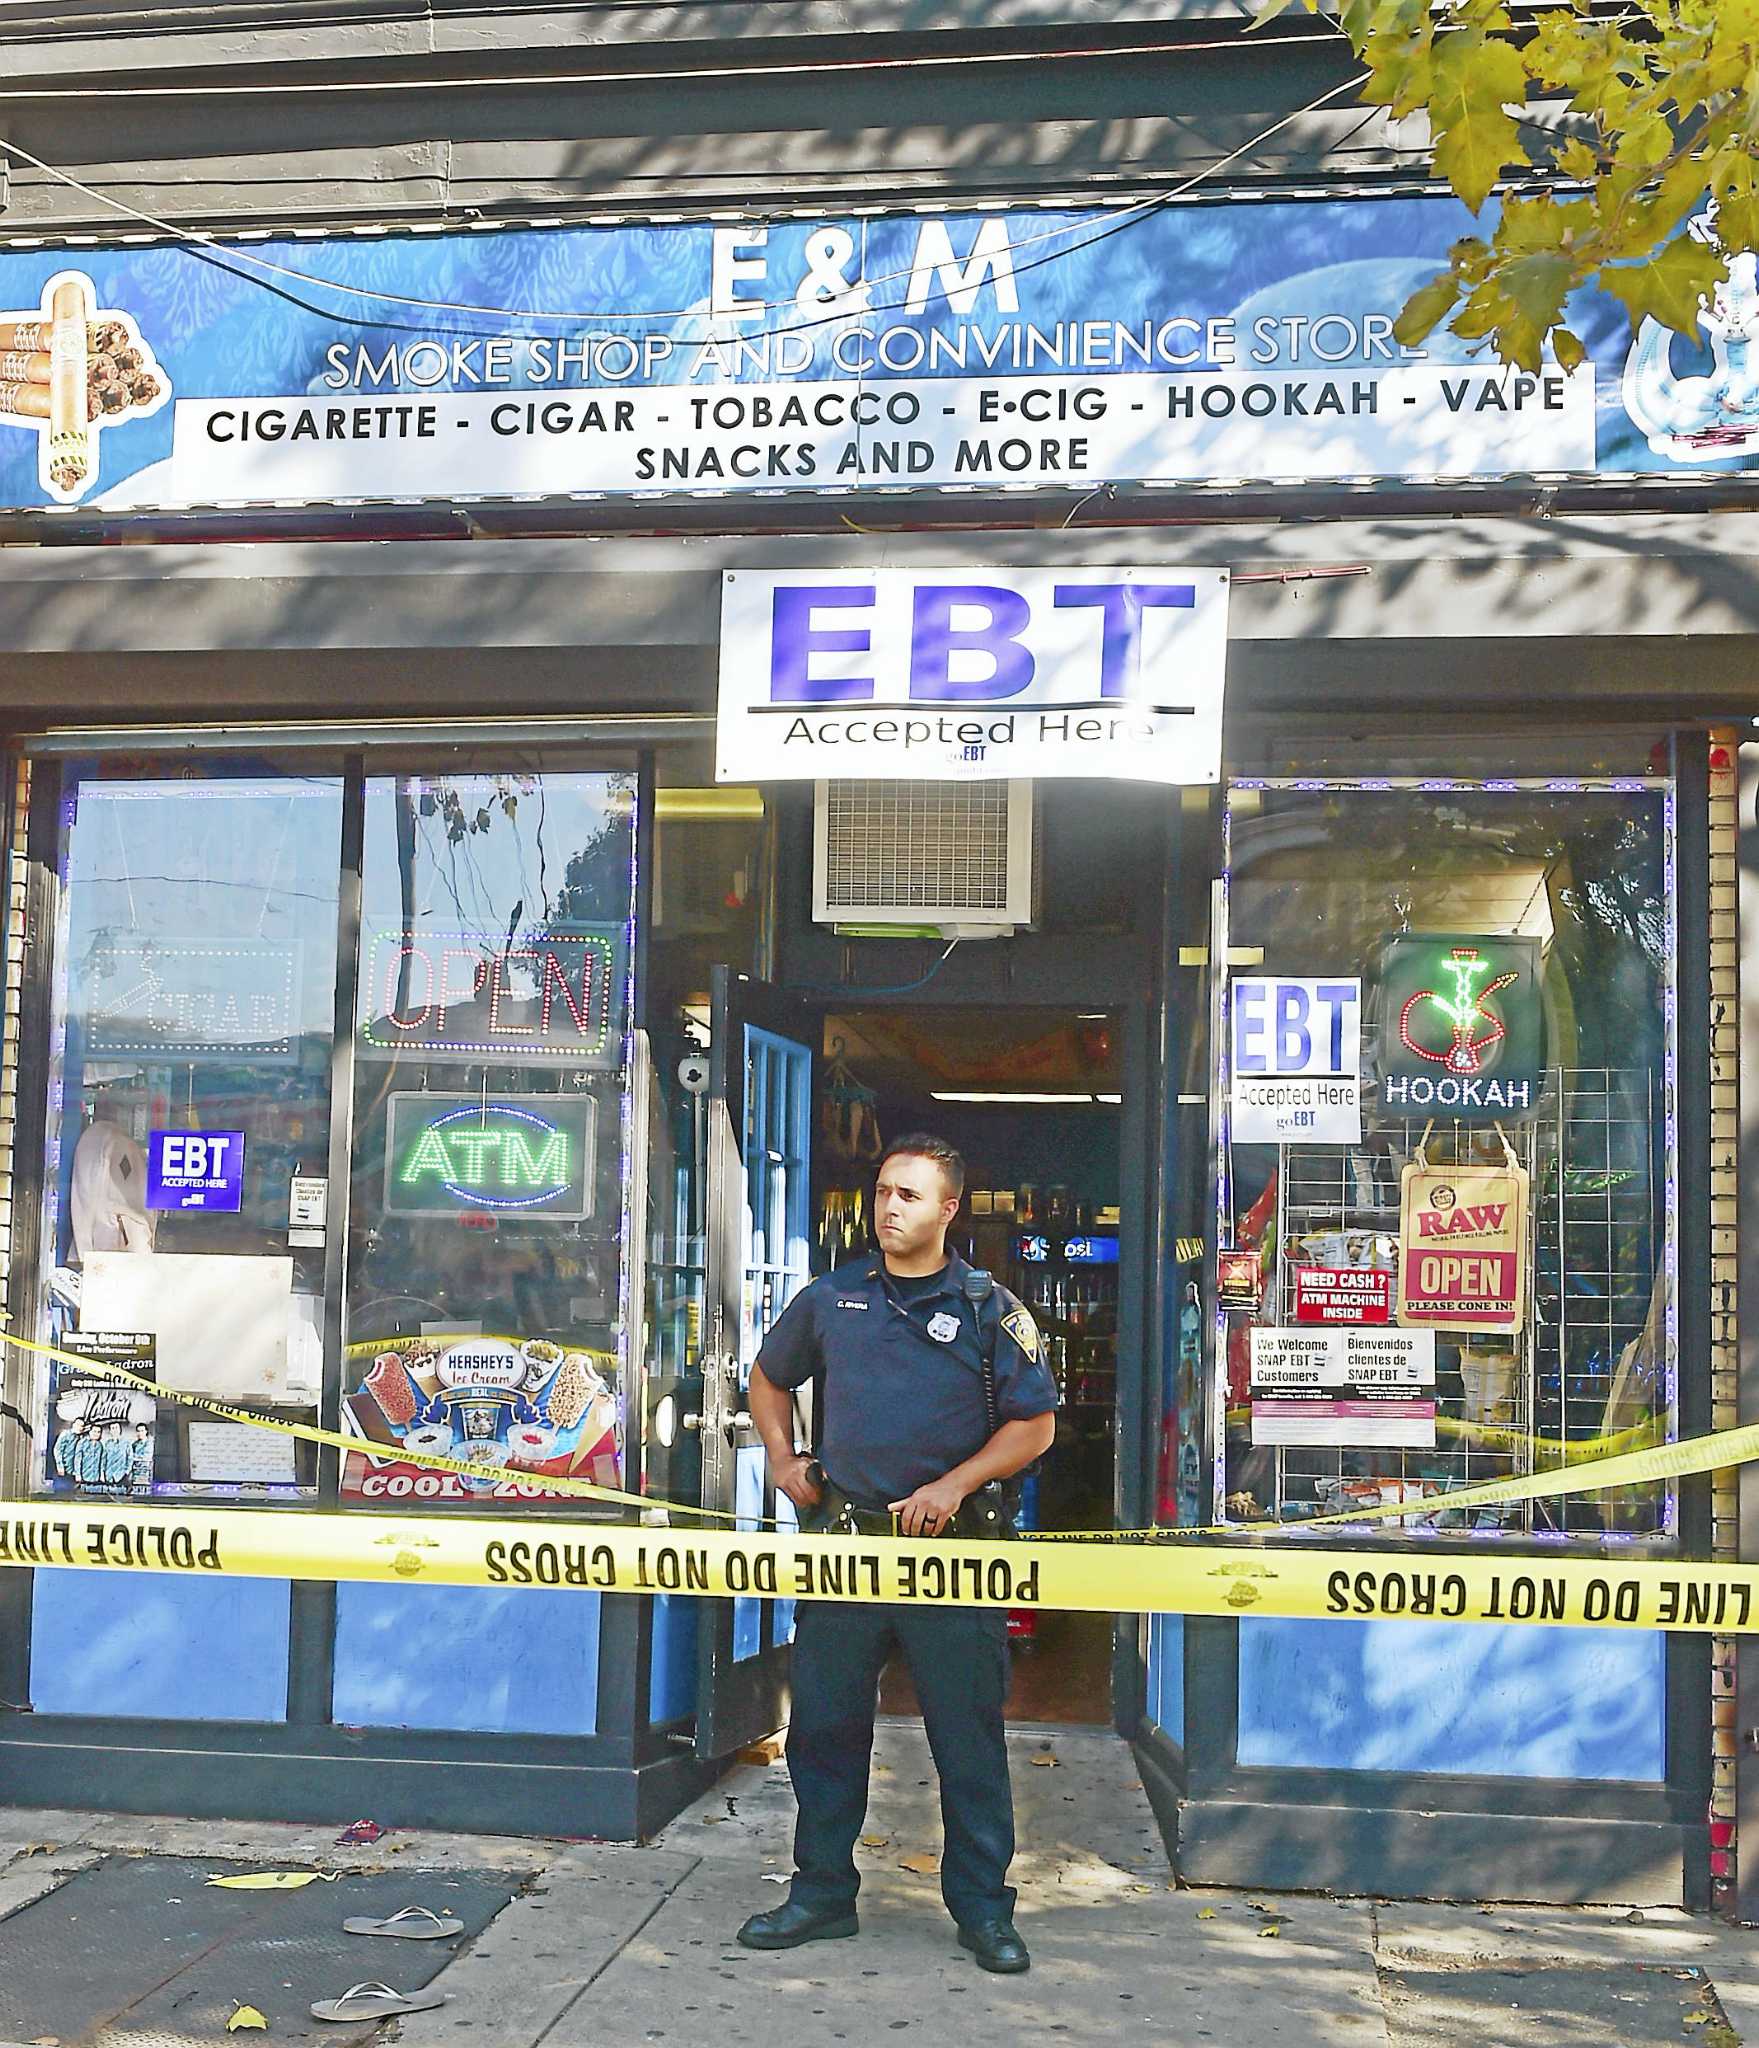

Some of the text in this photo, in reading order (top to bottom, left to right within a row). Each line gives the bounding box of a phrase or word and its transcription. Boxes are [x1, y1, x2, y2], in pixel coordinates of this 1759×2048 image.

[711, 218, 1020, 322] E & M
[324, 337, 512, 390] SMOKE
[526, 333, 672, 384] SHOP
[689, 329, 816, 377] AND
[832, 316, 1237, 375] CONVINIENCE
[206, 409, 436, 443] CIGARETTE
[490, 401, 634, 437] CIGAR
[689, 390, 921, 430] TOBACCO
[1169, 382, 1379, 420] HOOKAH
[1440, 378, 1564, 413] VAPE
[635, 438, 1089, 480] SNACKS AND MORE
[770, 584, 1196, 703] EBT
[784, 715, 1015, 748] Accepted
[386, 949, 594, 1036] OPEN
[147, 993, 281, 1033] CIGAR
[1236, 984, 1357, 1072] EBT
[1239, 1082, 1354, 1110] Accepted Here
[1386, 1075, 1530, 1109] HOOKAH
[1276, 1111, 1316, 1128] goEBT
[162, 1136, 230, 1178] EBT
[402, 1129, 571, 1184] ATM
[161, 1178, 229, 1189] ACCEPTED HERE
[1417, 1202, 1508, 1238] RAW
[1300, 1272, 1386, 1289] NEED CASH ?
[1420, 1256, 1502, 1297] OPEN
[1301, 1293, 1386, 1307] ATM MACHINE
[1322, 1307, 1363, 1319] INSIDE
[1408, 1301, 1513, 1311] PLEASE CONE IN!
[1257, 1339, 1329, 1351] We Welcome
[1348, 1338, 1413, 1350] Bienvenidos
[1393, 1354, 1407, 1366] de
[448, 1355, 514, 1370] HERSHEY'S
[1257, 1355, 1310, 1367] SNAP EBT
[1257, 1370, 1319, 1382] Customers
[1348, 1369, 1398, 1381] SNAP EBT
[452, 1371, 511, 1385] Ice Cream
[362, 1475, 464, 1497] COOL
[86, 1524, 223, 1570] POLICE
[485, 1540, 1040, 1602] POLICE LINE DO NOT CROSS
[1326, 1570, 1752, 1626] LINE DO NOT CROSS
